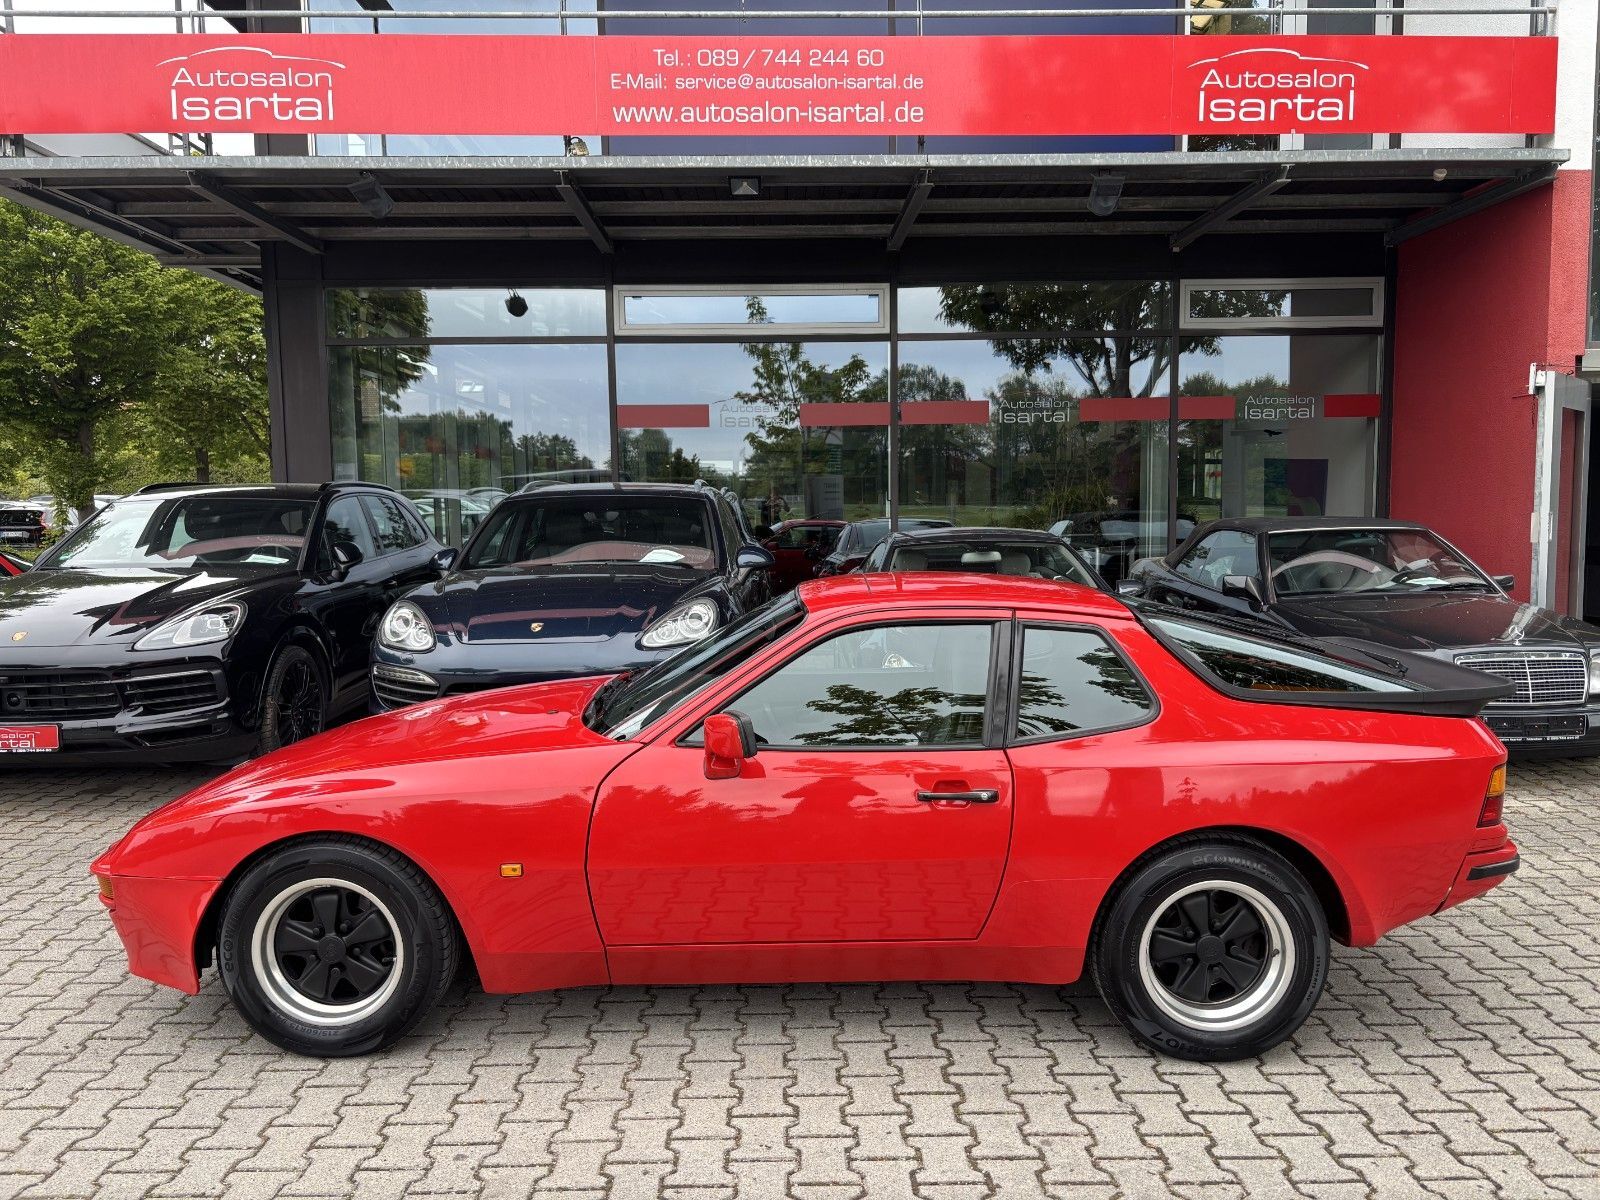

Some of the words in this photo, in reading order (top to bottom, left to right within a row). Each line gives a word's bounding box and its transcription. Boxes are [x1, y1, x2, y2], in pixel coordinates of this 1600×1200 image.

[653, 49, 691, 67] Tel.:
[697, 49, 738, 67] 089
[761, 49, 801, 67] 744
[808, 49, 850, 67] 244
[856, 49, 884, 67] 60
[171, 67, 333, 88] Autosalon
[610, 73, 668, 90] E-Mail:
[674, 73, 924, 90] service@autosalon-isartal.de
[1200, 68, 1355, 89] Autosalon
[170, 89, 334, 121] Isartal
[612, 100, 925, 123] www.autosalon-isartal.de
[1198, 89, 1355, 122] Isartal
[999, 399, 1070, 409] Autosalon
[1245, 395, 1315, 405] Autosalon
[999, 408, 1070, 424] Isartal
[1244, 404, 1315, 420] Isartal
